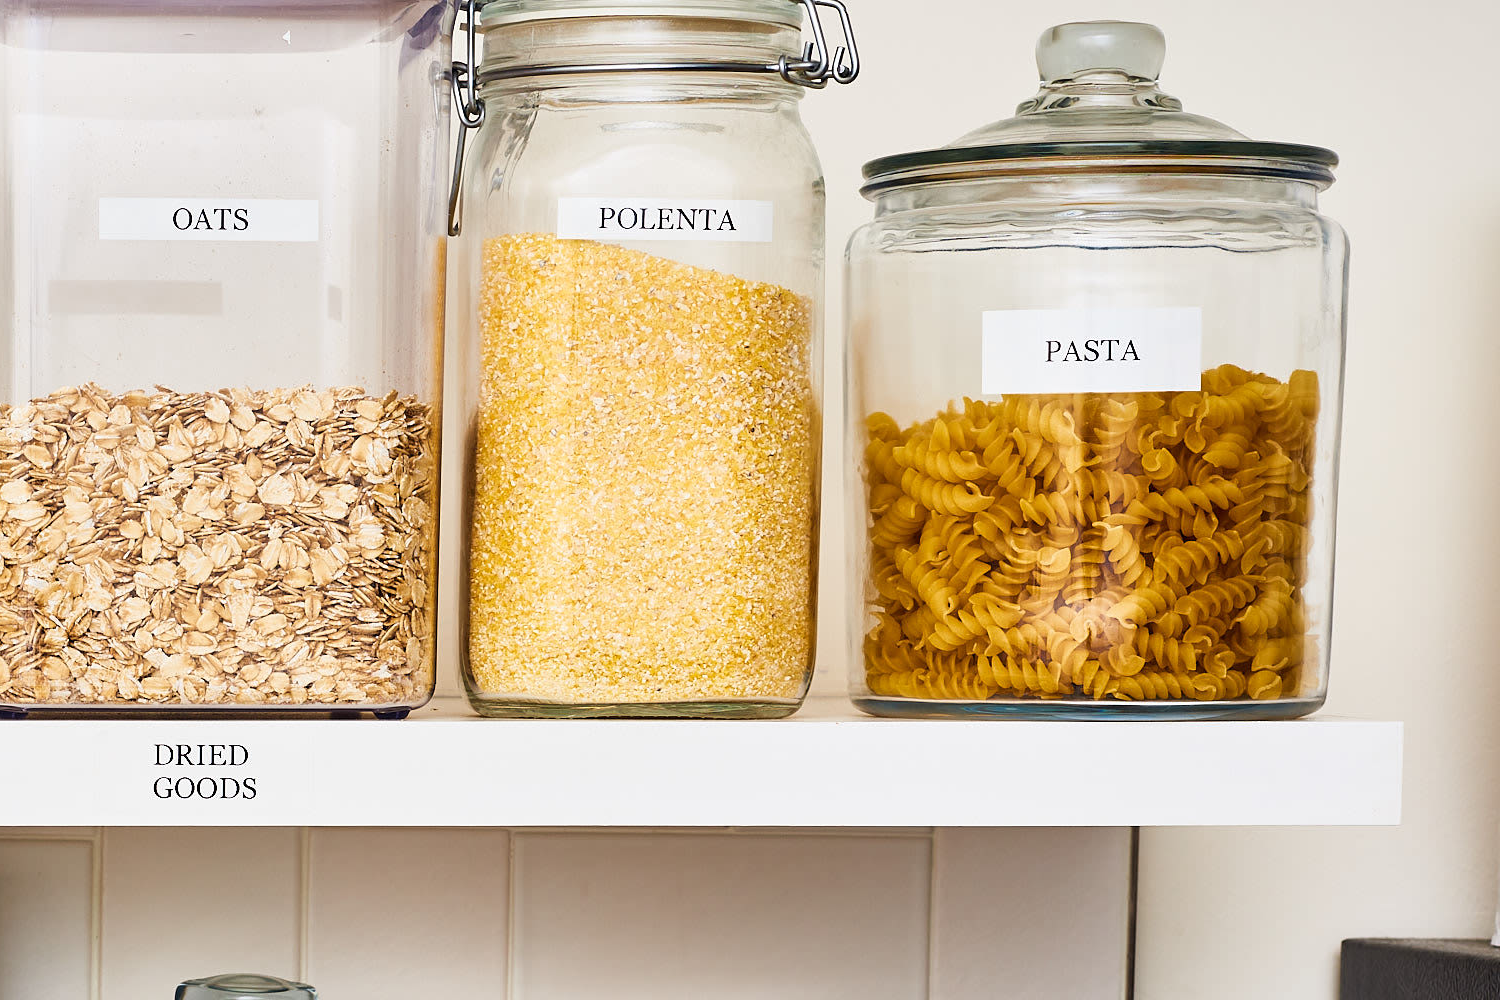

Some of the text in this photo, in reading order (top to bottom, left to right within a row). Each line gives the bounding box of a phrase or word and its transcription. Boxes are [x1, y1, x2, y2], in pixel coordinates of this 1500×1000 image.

[172, 207, 250, 231] OATS
[598, 207, 737, 231] POLENTA
[1045, 339, 1141, 363] PASTA
[153, 743, 249, 766] DRIED
[153, 776, 257, 800] GOODS
